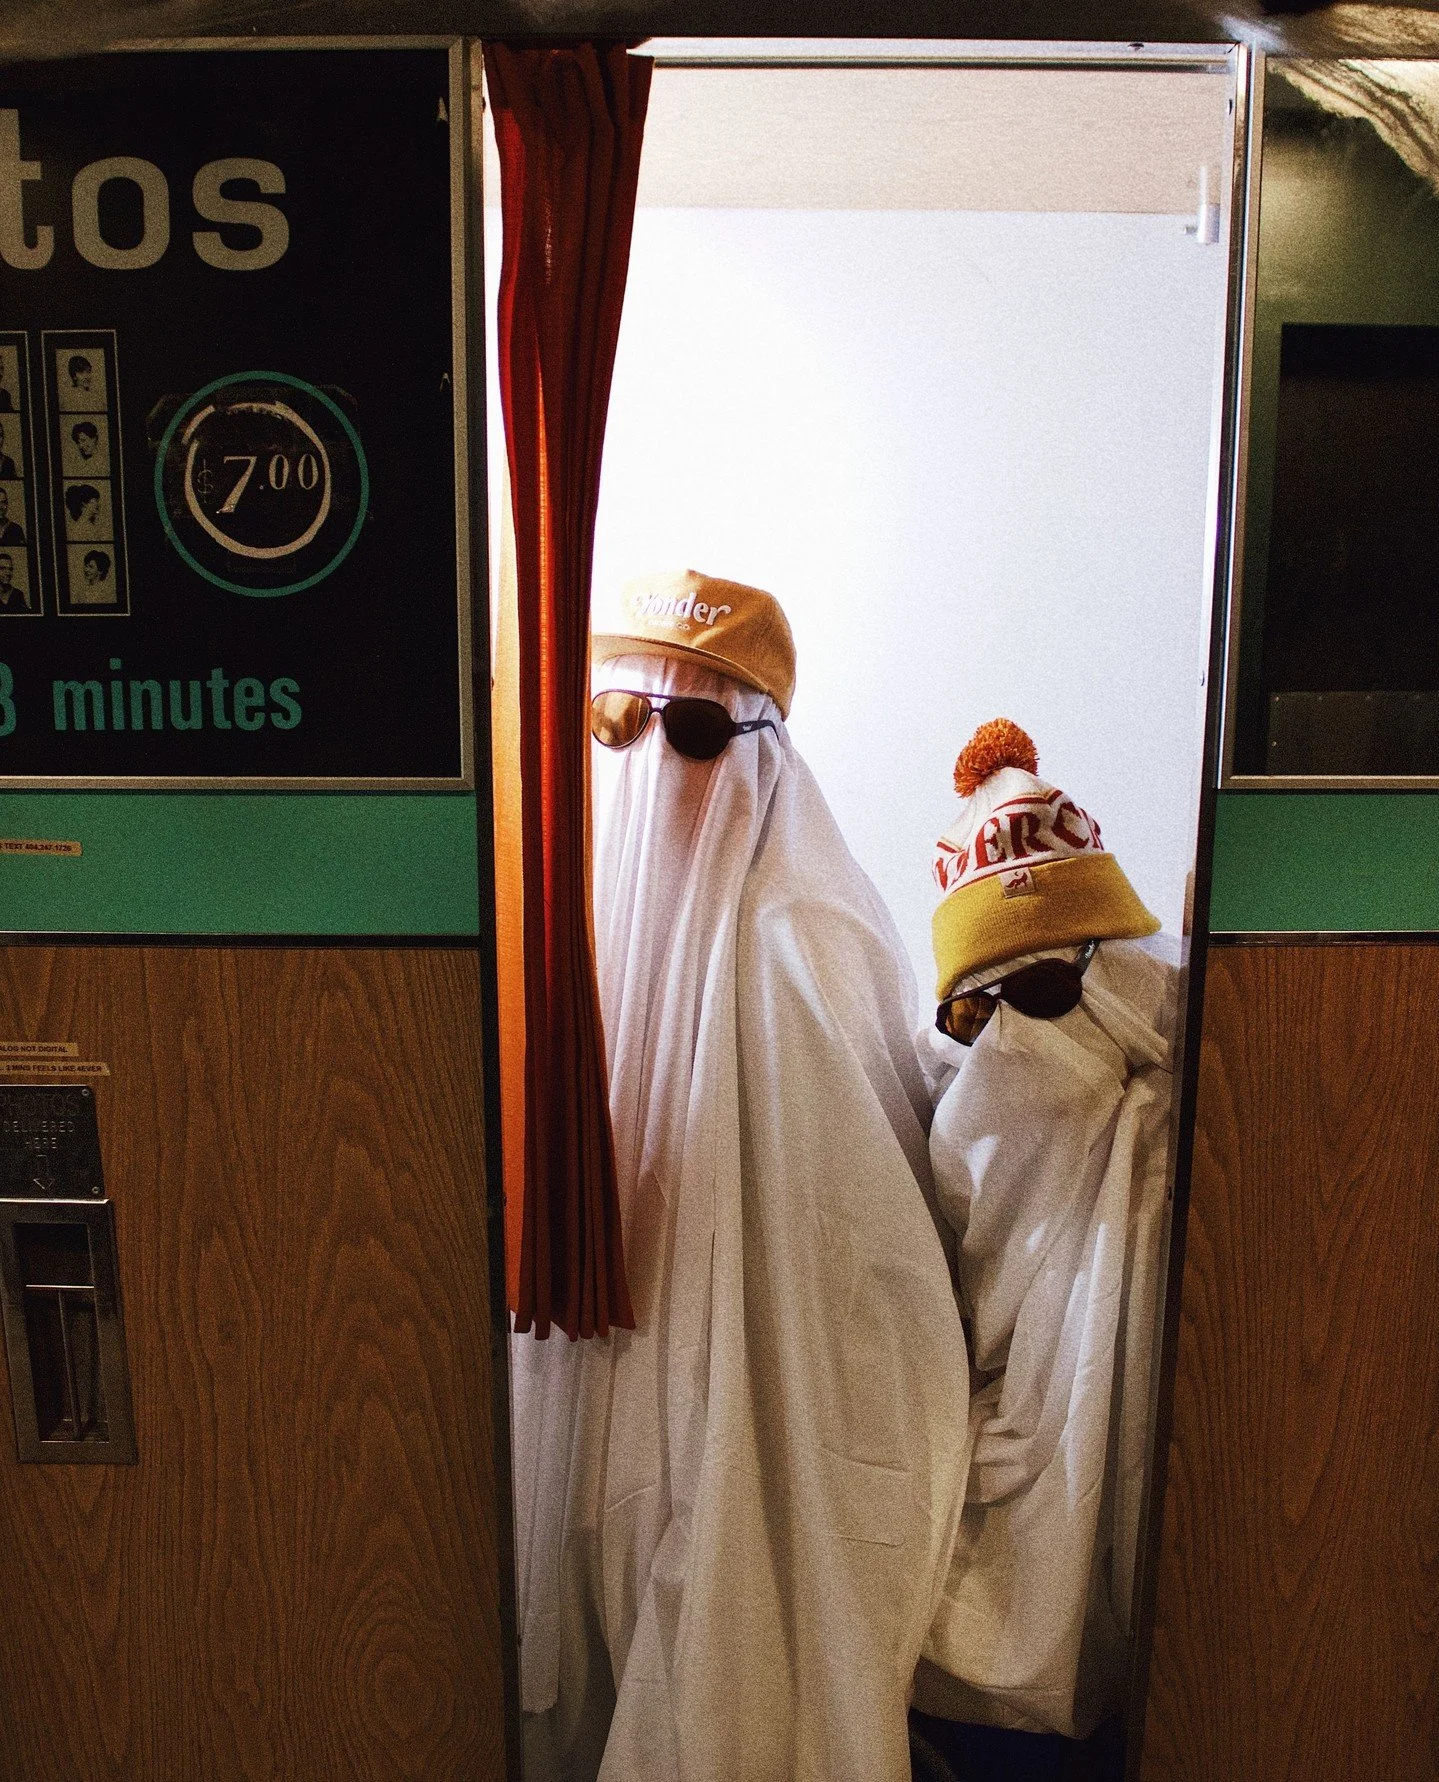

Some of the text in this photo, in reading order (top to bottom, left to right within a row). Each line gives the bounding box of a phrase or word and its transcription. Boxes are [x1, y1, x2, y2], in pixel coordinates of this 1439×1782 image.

[52, 657, 302, 731] minutes
[4, 842, 22, 850] TEXT
[21, 1045, 36, 1053] NOT
